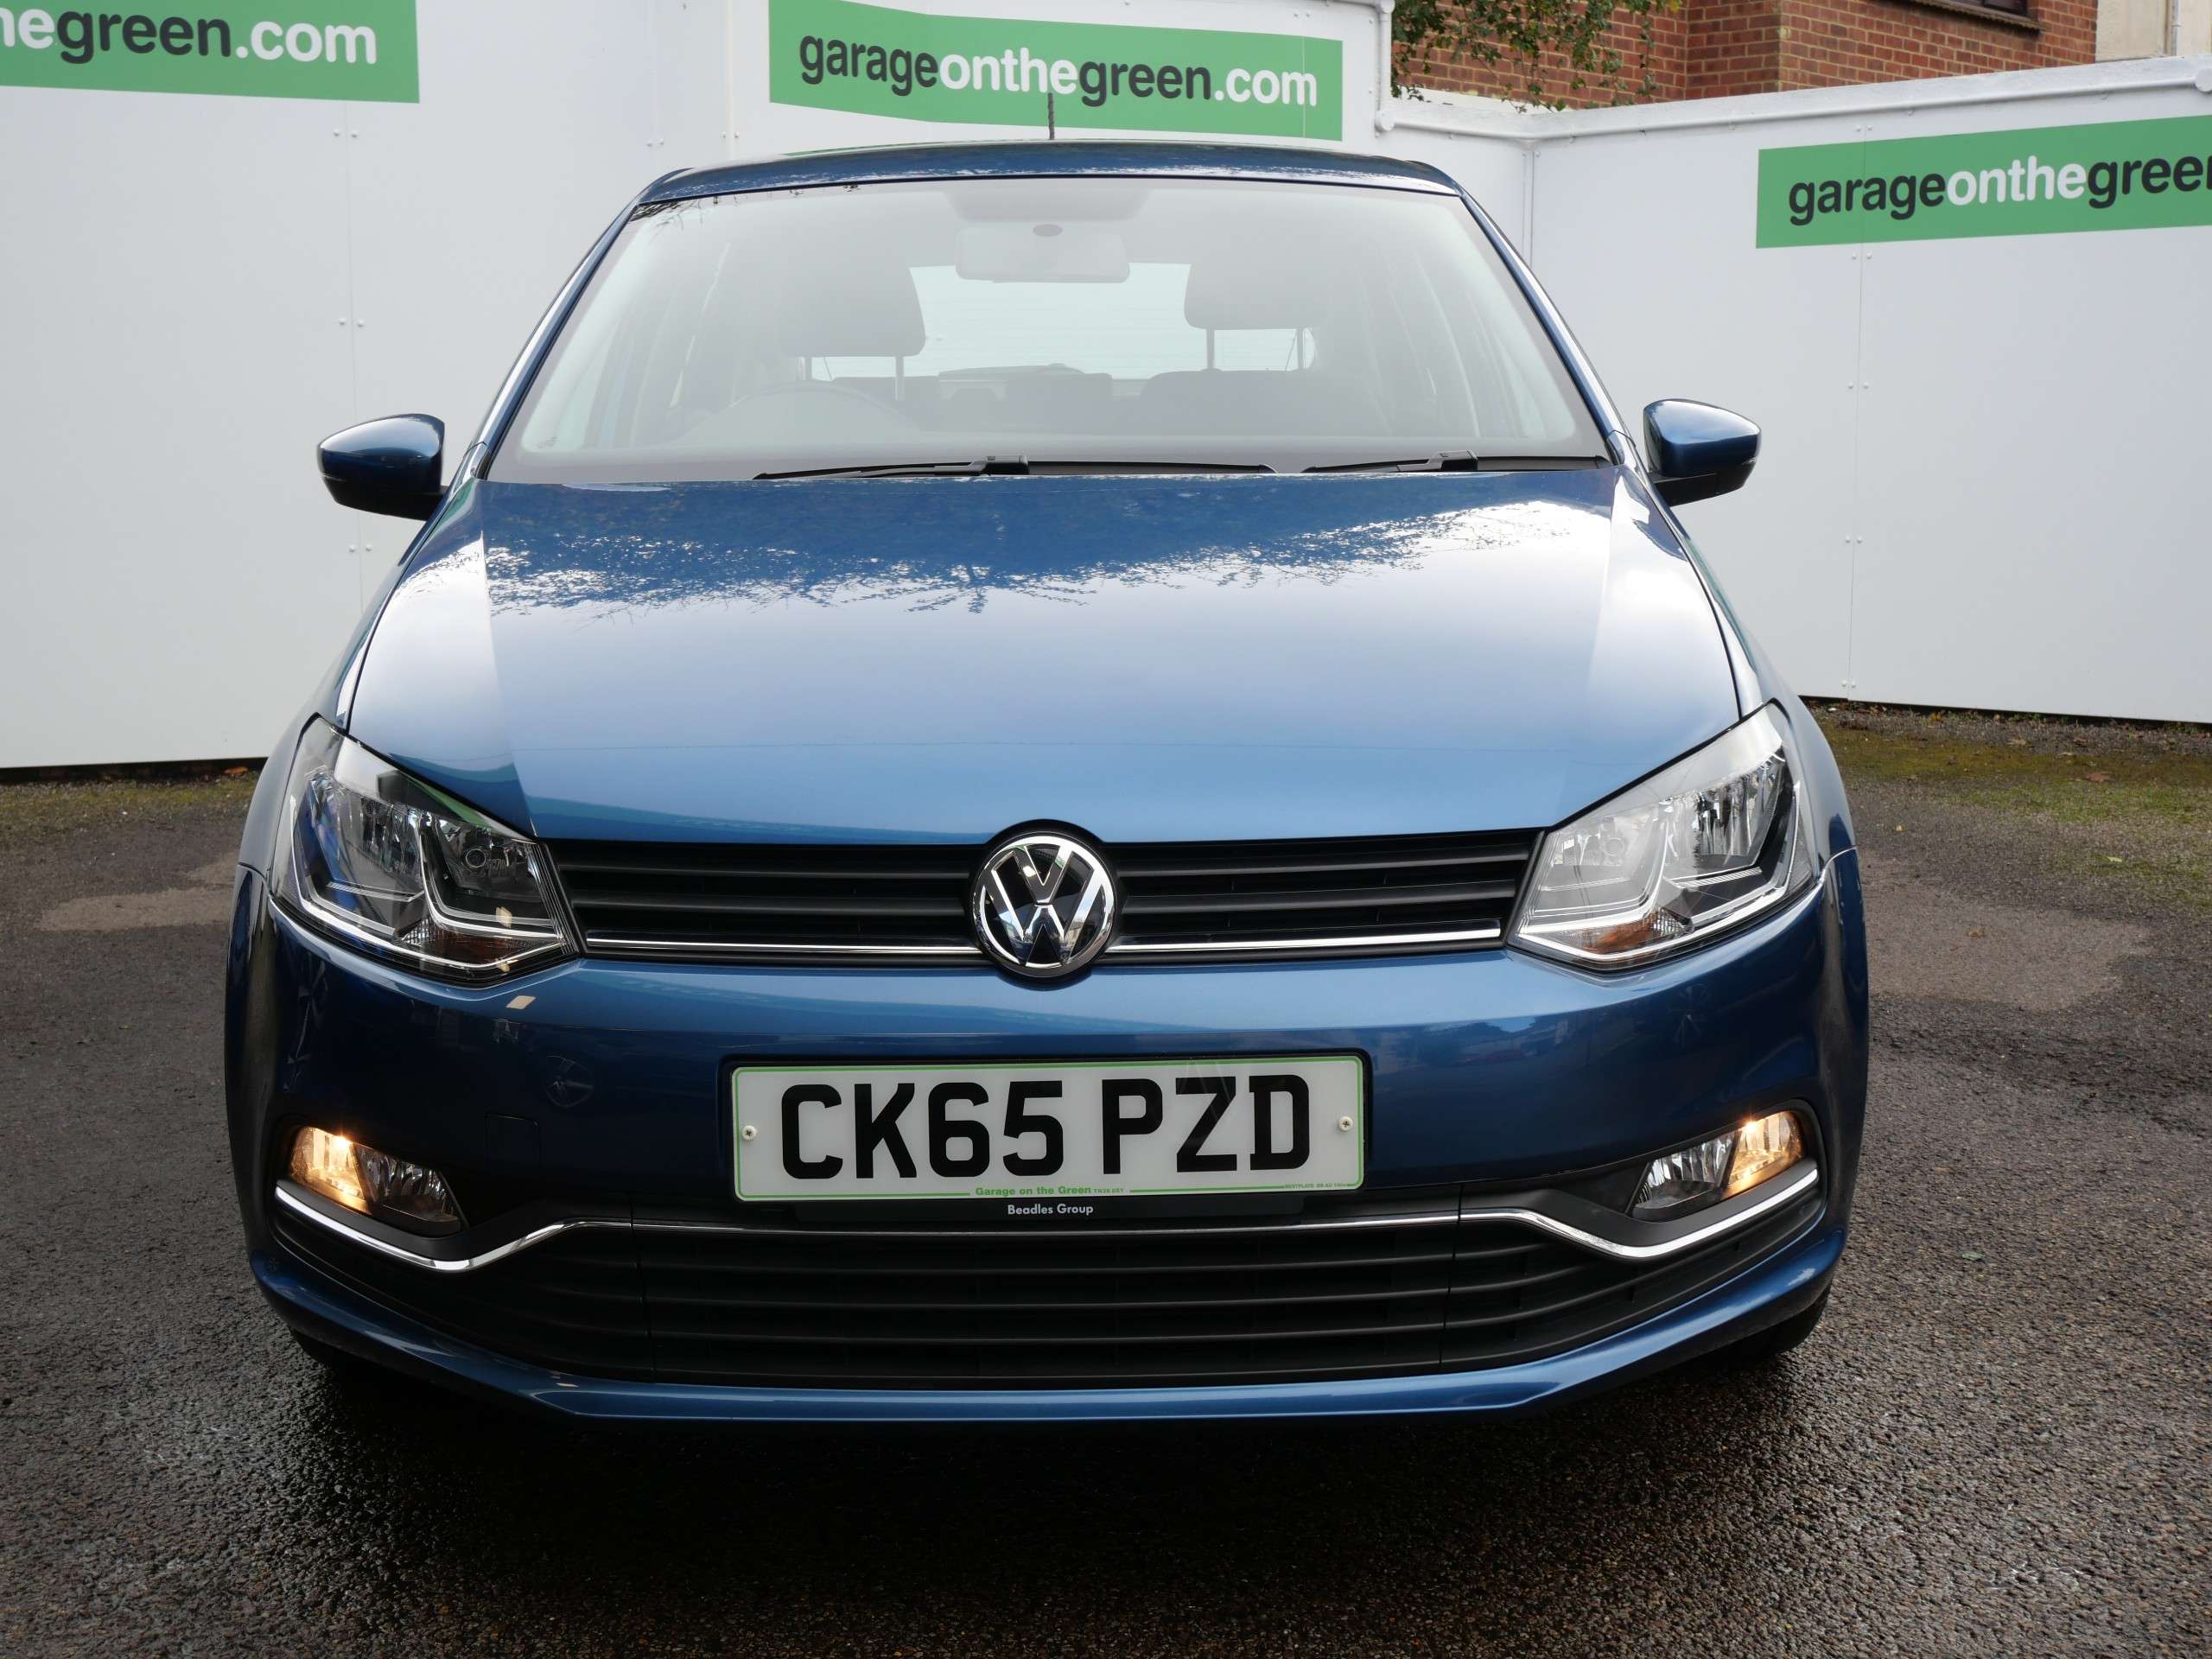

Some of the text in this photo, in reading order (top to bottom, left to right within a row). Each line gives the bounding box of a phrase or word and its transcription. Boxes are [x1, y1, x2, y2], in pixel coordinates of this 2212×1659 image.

[798, 35, 1317, 107] garageonthegreen.com
[1788, 155, 2212, 226] garageonthegree
[780, 1074, 1311, 1180] CK65 PZD
[975, 1187, 1016, 1197] Garage
[1058, 1185, 1091, 1194] Green
[1007, 1203, 1094, 1216] Beadles Group
